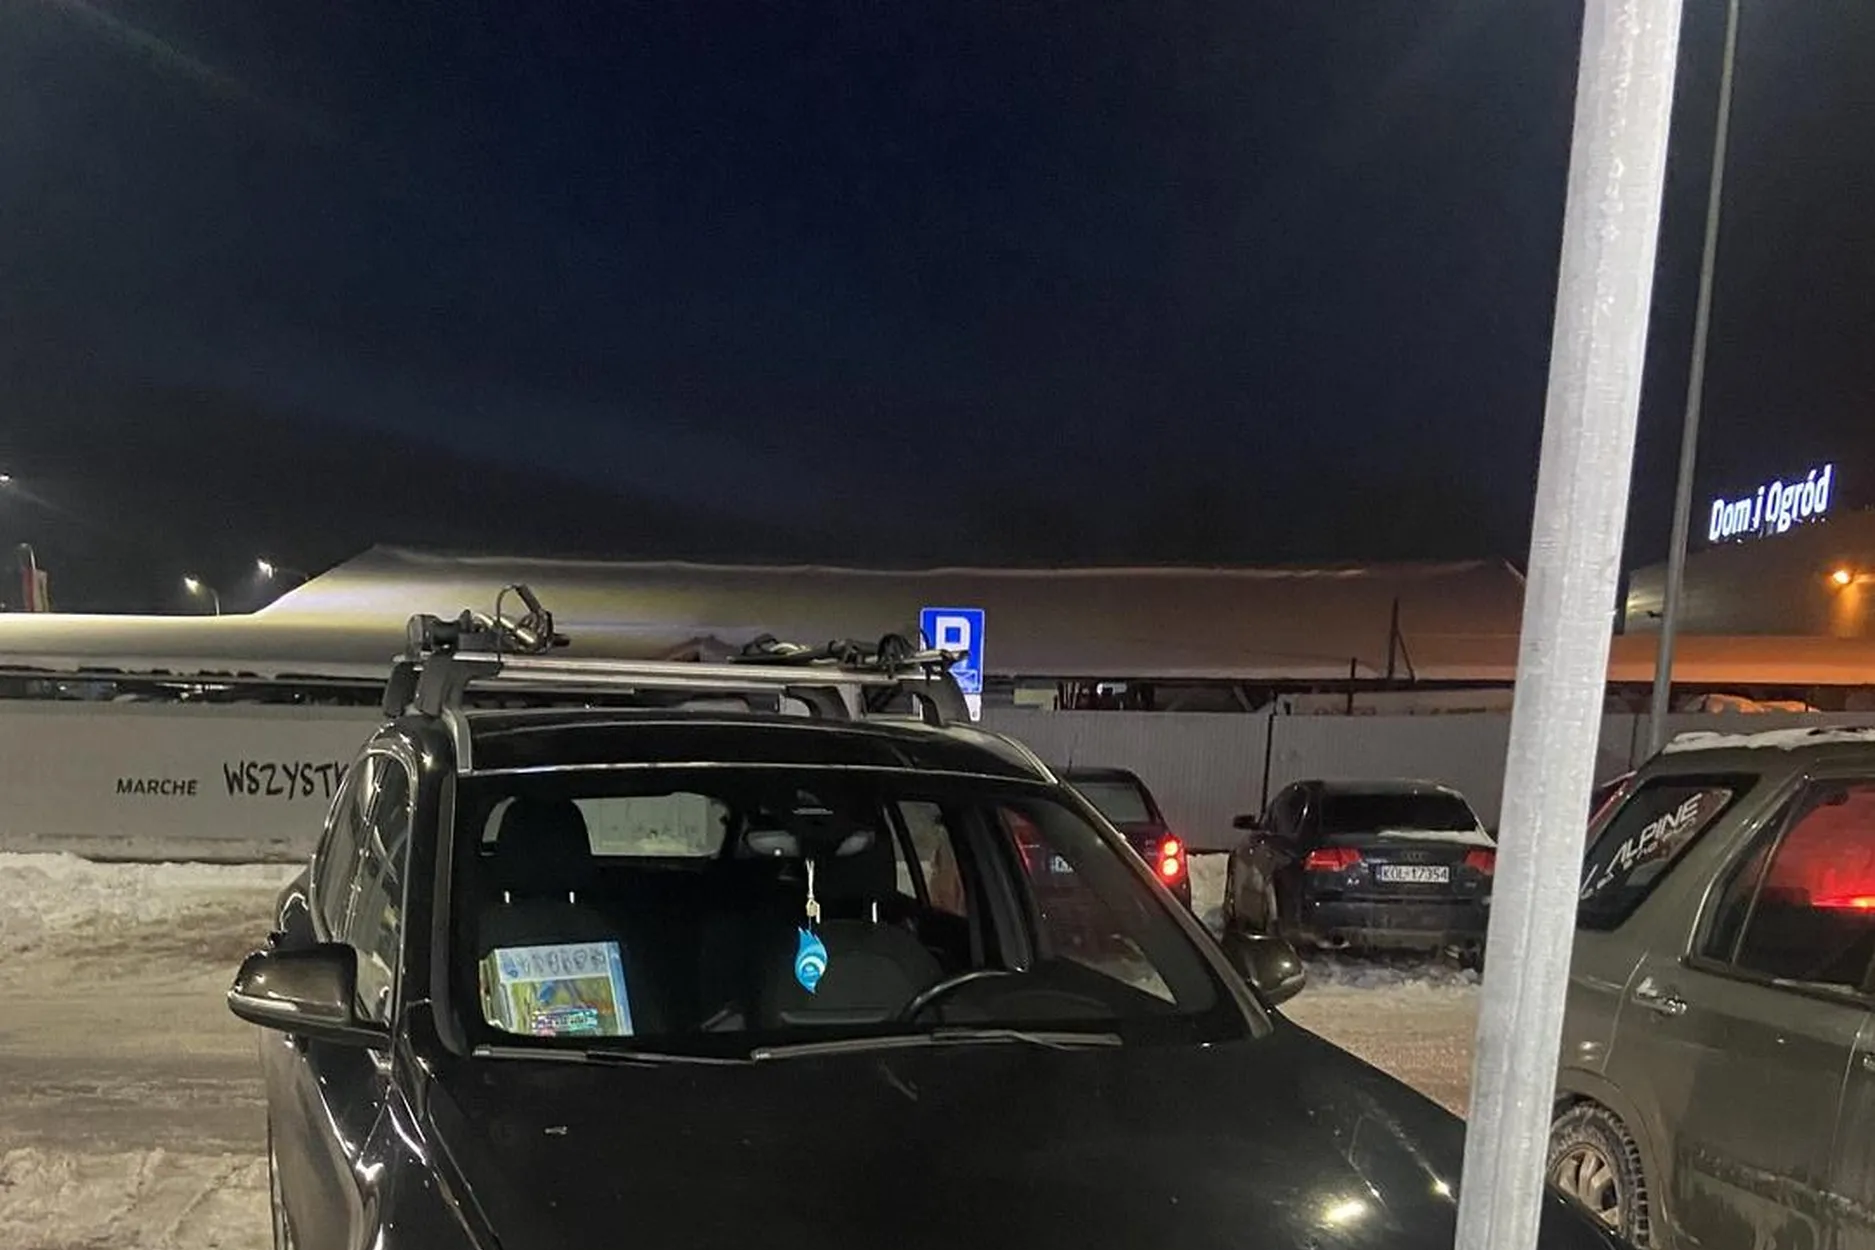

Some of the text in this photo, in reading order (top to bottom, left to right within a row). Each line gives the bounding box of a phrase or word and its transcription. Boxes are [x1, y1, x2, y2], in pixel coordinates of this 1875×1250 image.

[1709, 464, 1832, 541] Dom i Ogród
[116, 778, 198, 796] MARCHE
[1606, 793, 1703, 876] ALPINE
